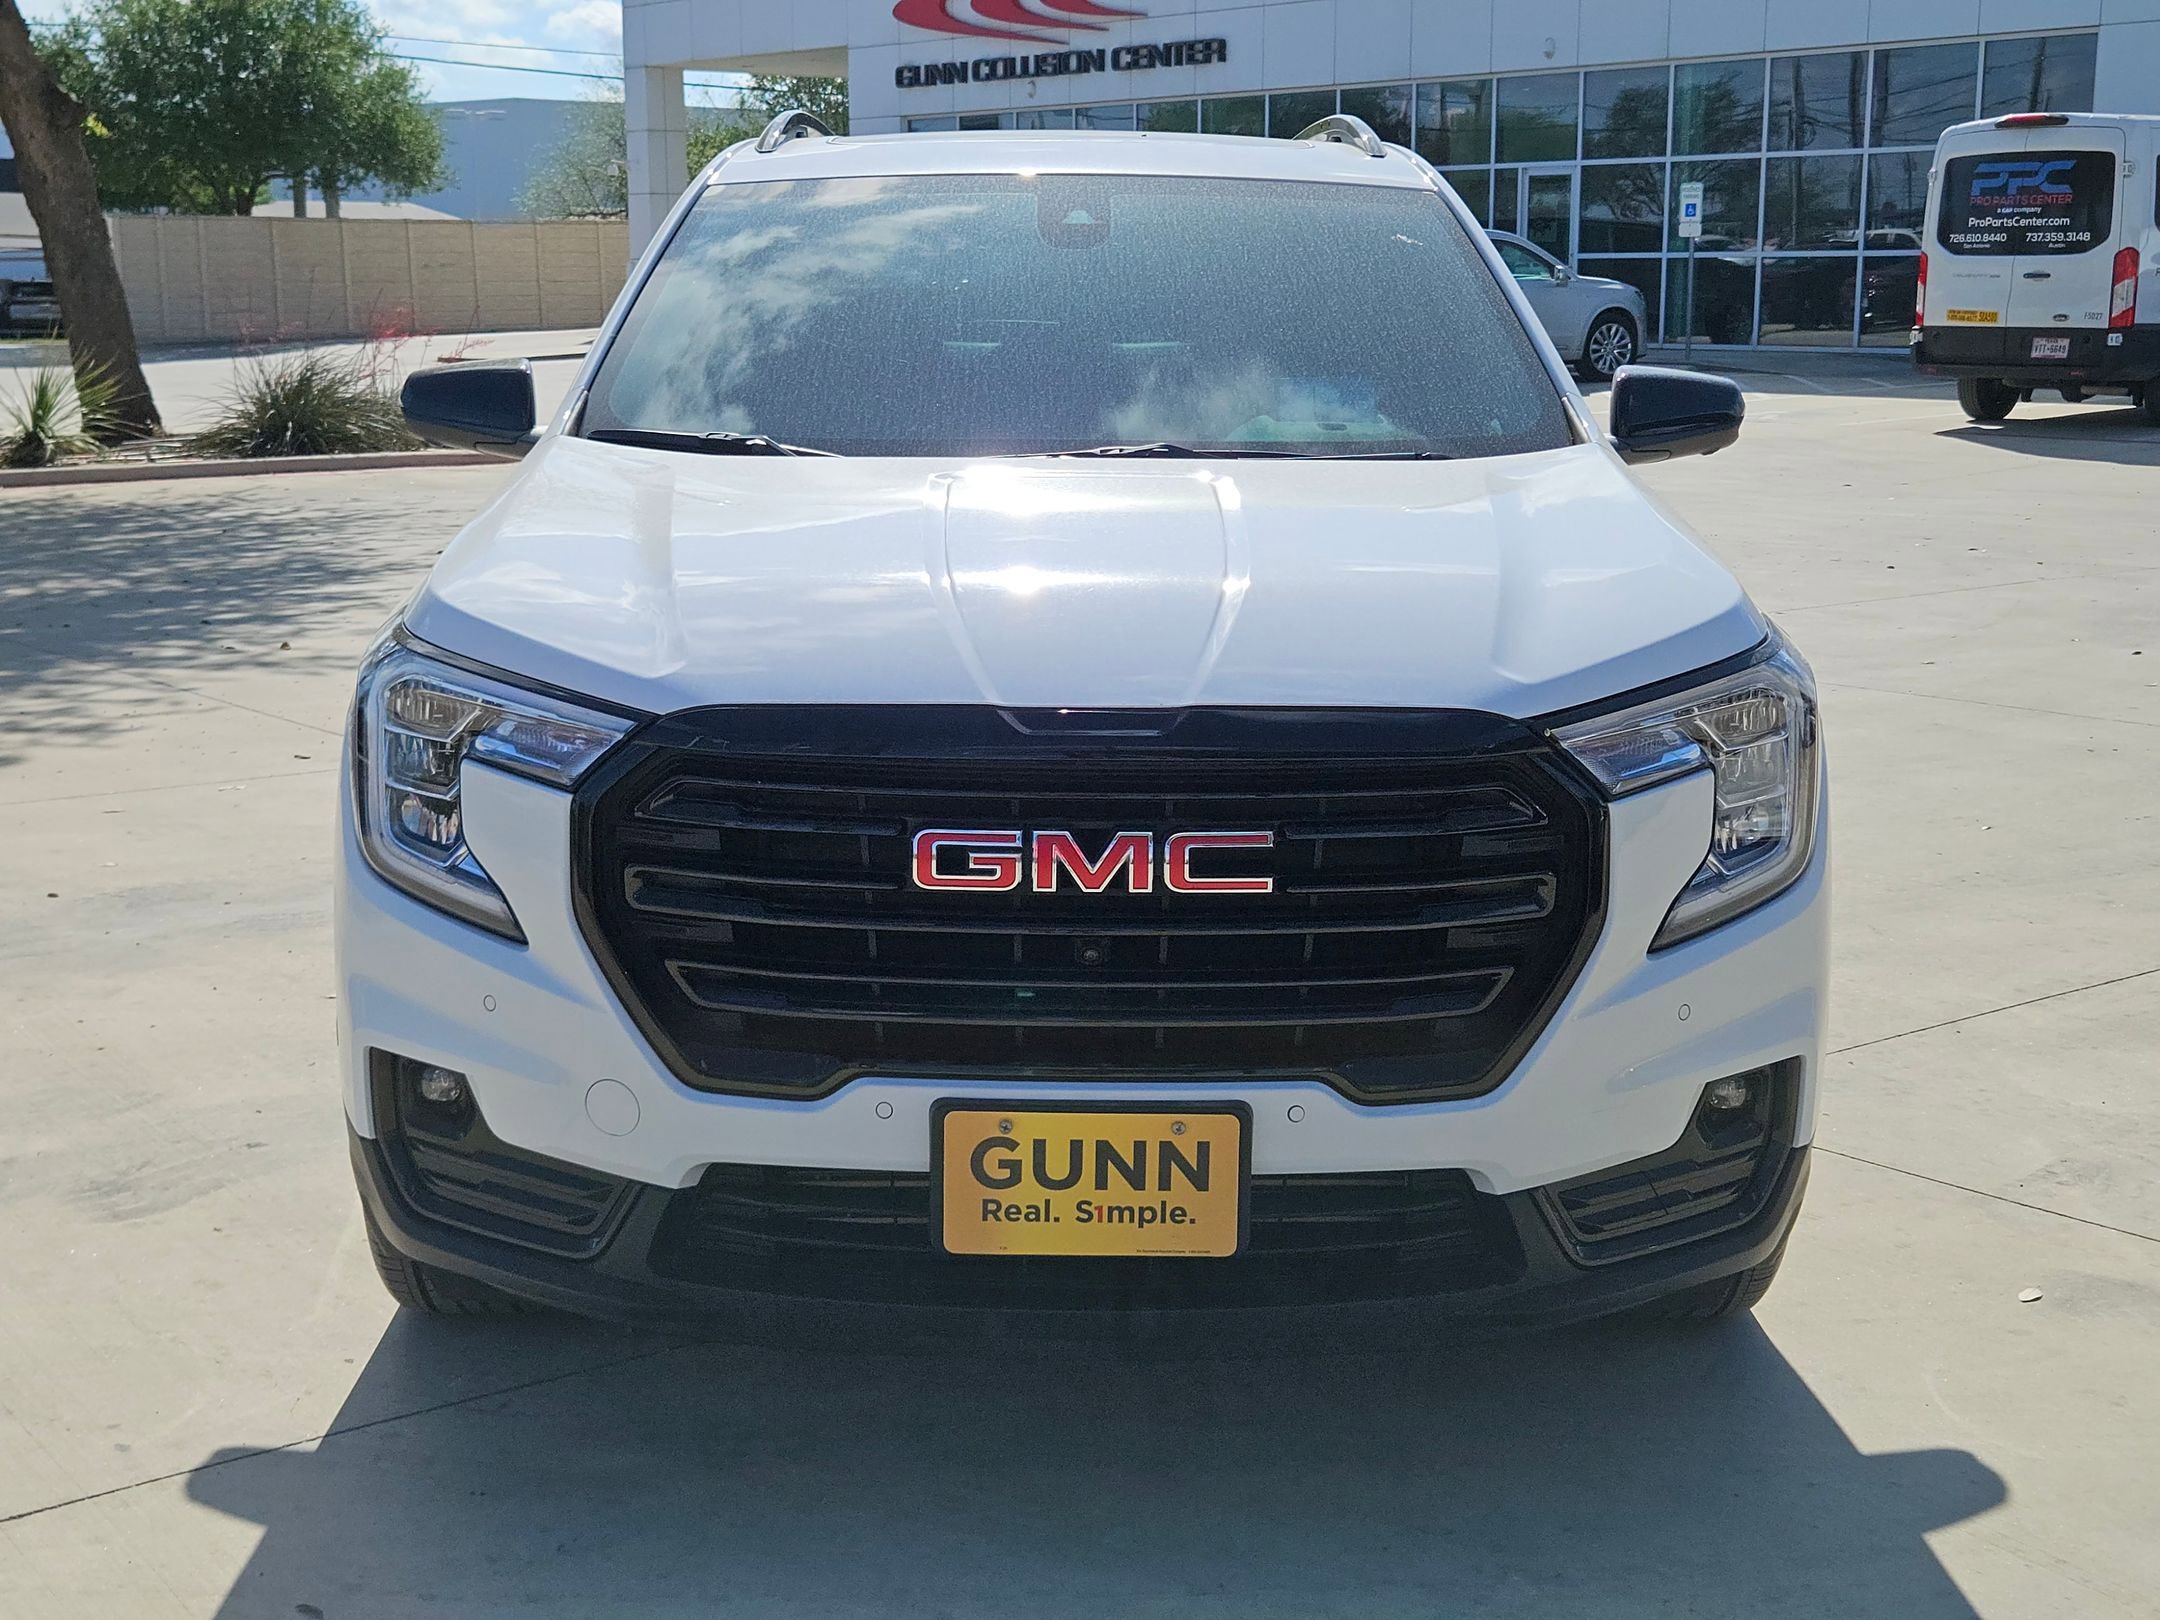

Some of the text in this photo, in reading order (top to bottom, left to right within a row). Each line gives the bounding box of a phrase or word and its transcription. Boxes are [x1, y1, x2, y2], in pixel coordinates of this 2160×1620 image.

[895, 38, 1227, 88] GUNN COLLISION CENTER
[1970, 160, 2077, 196] PPC
[1969, 194, 2073, 206] PRO PARTS CENTER
[1968, 217, 2070, 228] ProPartsCenter.com
[1949, 233, 2007, 243] 726.610.8440
[2025, 232, 2091, 242] 737.359.3148
[912, 829, 1274, 893] GMC
[970, 1136, 1211, 1192] GUNN
[981, 1198, 1060, 1223] Real.
